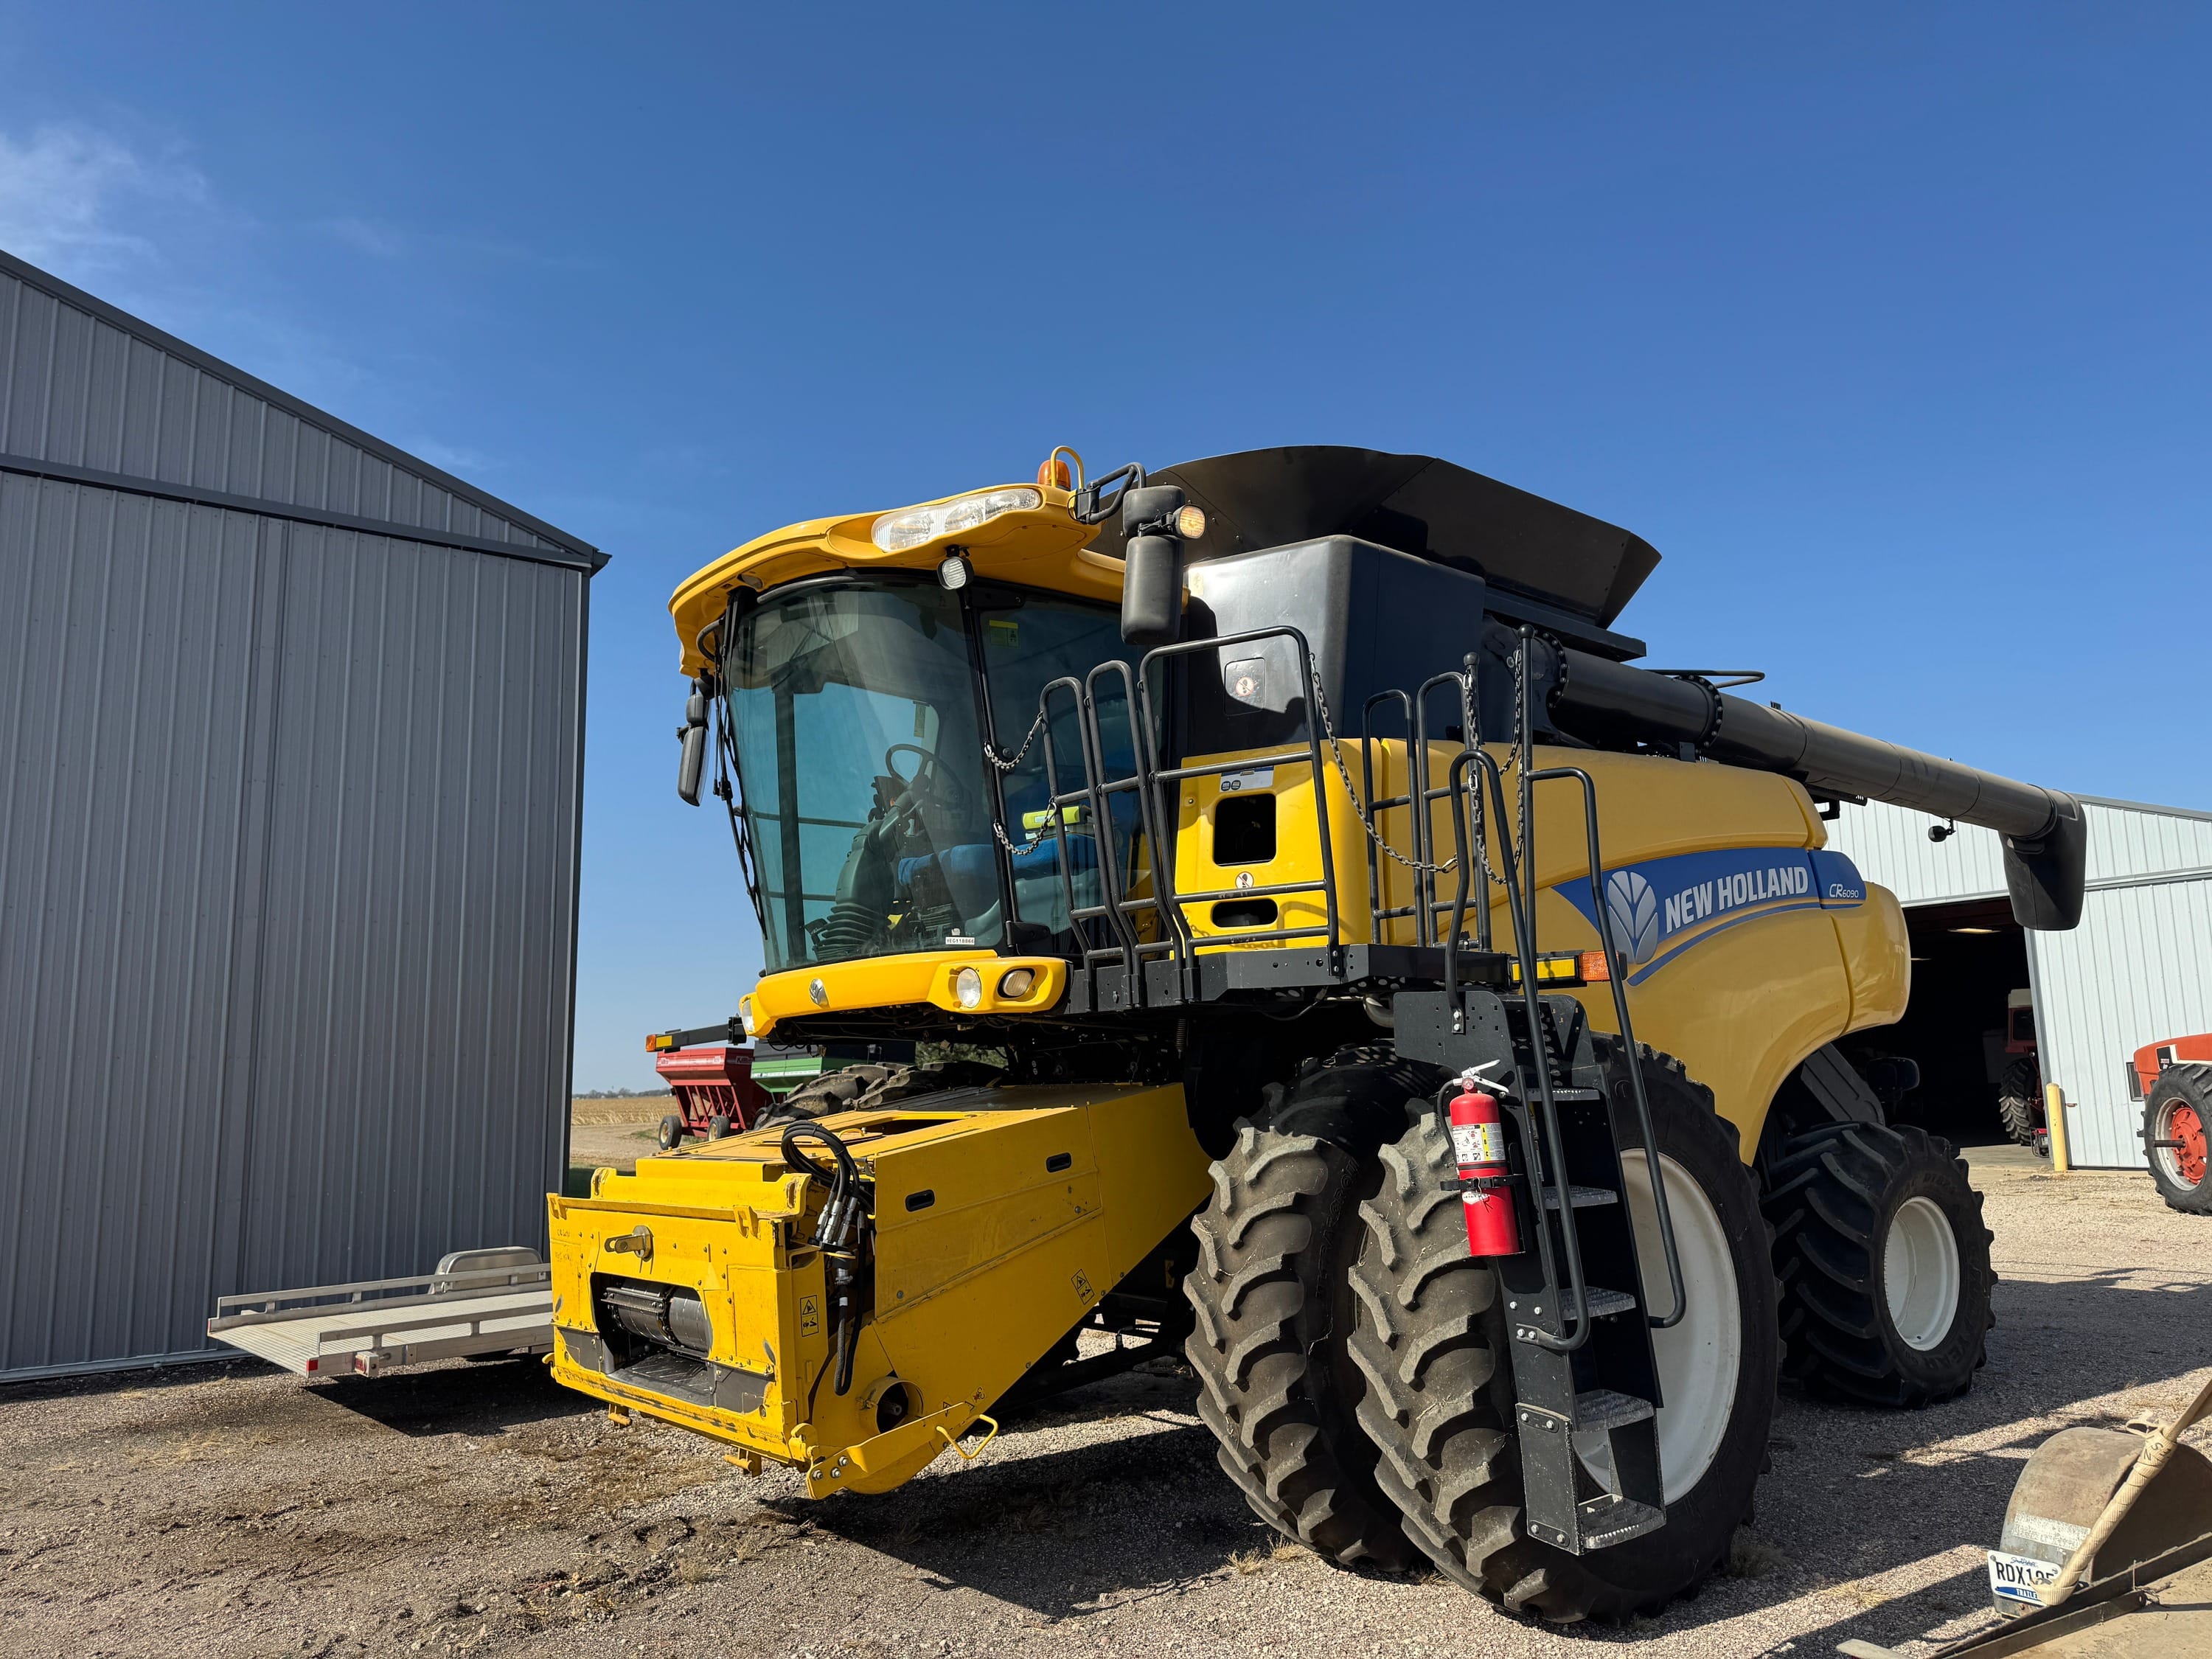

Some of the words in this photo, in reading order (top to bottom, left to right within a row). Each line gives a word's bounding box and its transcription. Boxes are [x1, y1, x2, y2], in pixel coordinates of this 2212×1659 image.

[1665, 881, 1712, 933] NEW
[1717, 867, 1809, 911] HOLLAND
[2017, 1588, 2038, 1599] TRAILE
